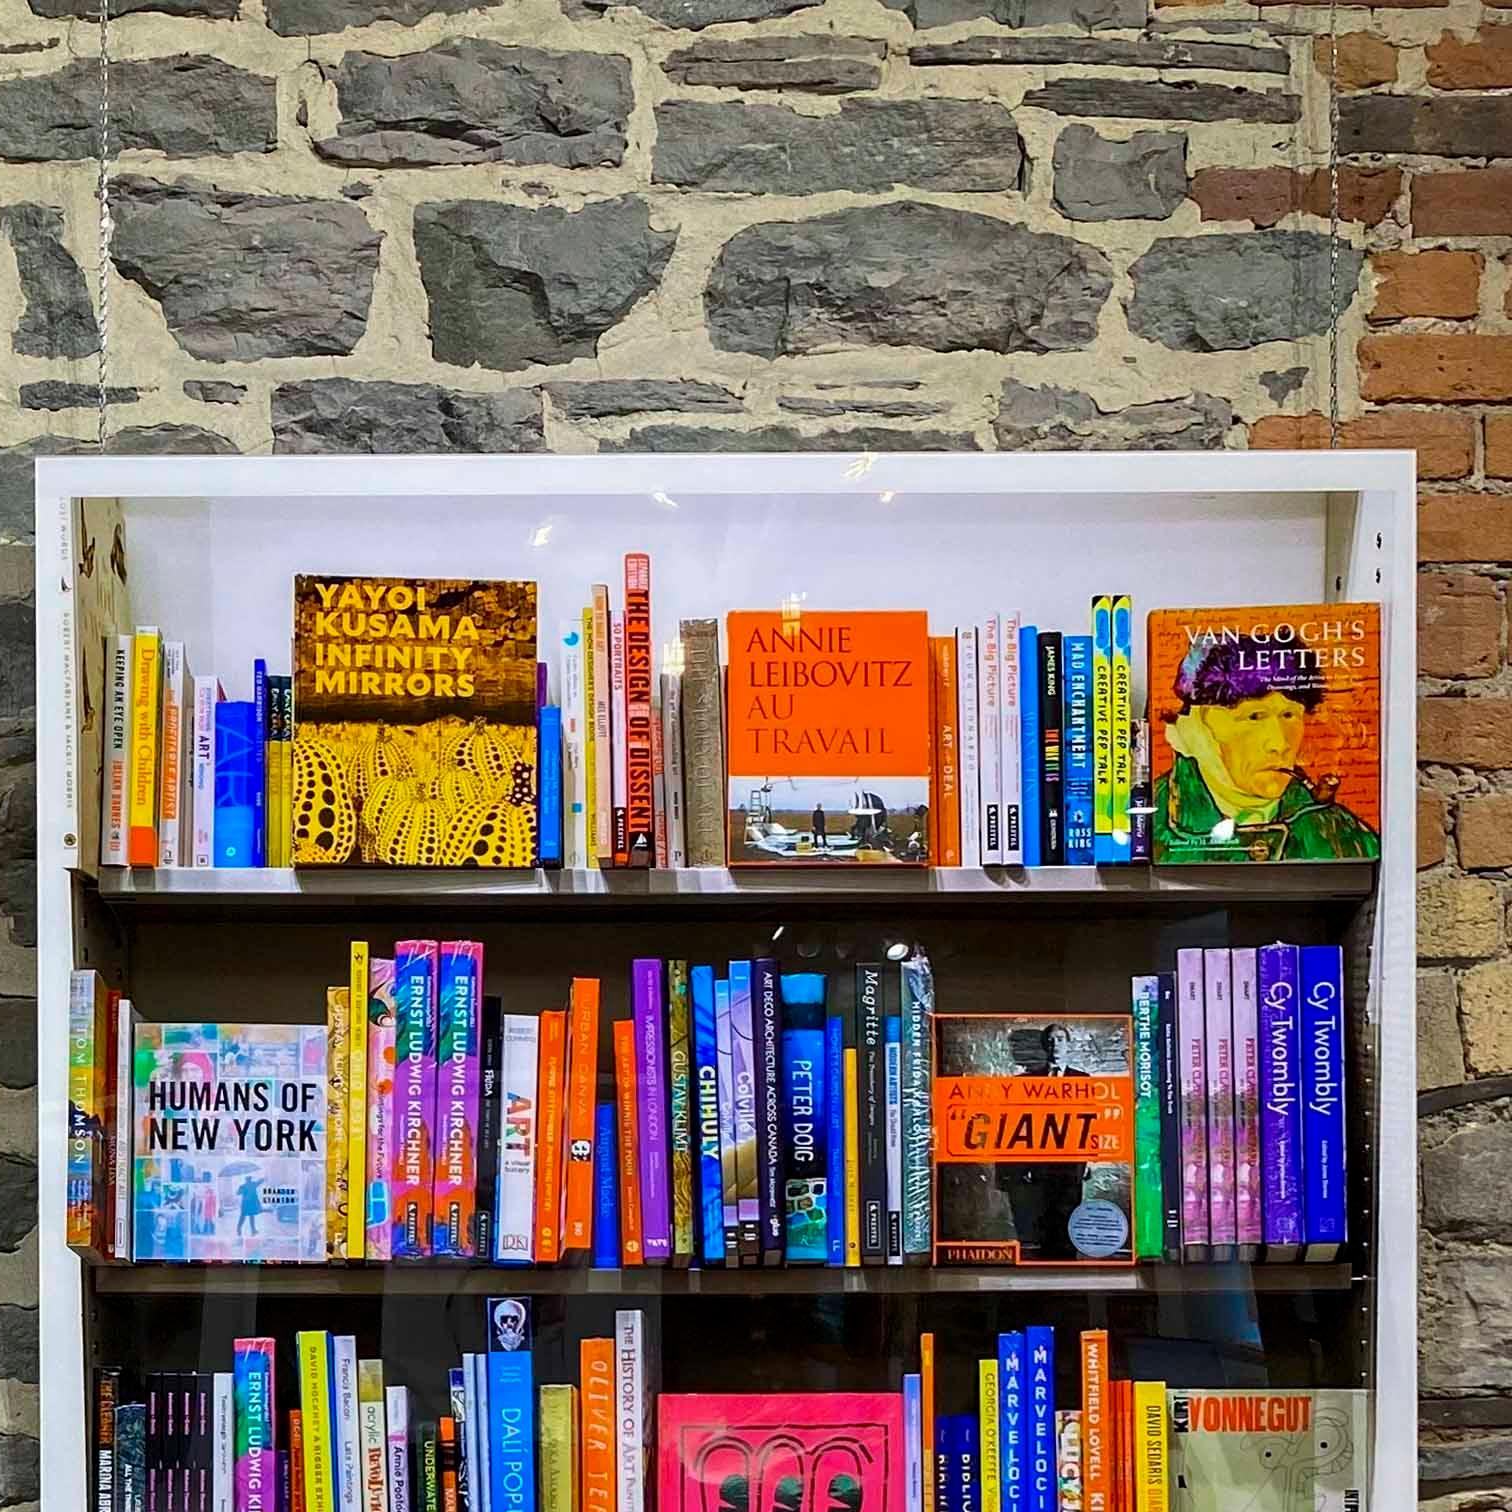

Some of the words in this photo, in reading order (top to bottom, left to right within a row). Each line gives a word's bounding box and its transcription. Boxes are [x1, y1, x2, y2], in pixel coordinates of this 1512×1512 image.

[315, 583, 426, 611] YAYOI
[626, 590, 649, 626] THE
[315, 612, 480, 641] KUSAMA
[746, 627, 851, 653] ANNIE
[1184, 624, 1240, 646] VAN
[1250, 620, 1365, 644] GOGH'S
[315, 643, 473, 671] INFINITY
[627, 631, 650, 704] DESIGN
[750, 661, 912, 688] LEIBOVITZ
[1070, 642, 1085, 670] MAD
[1238, 648, 1365, 671] LETTERS
[315, 671, 475, 698] MIRRORS
[747, 696, 793, 720] AU
[1070, 674, 1085, 769] ENCHANTMENT
[628, 716, 650, 741] OF
[747, 728, 893, 754] TRAVAIL
[629, 747, 652, 833] DISSENT
[410, 975, 425, 1027] ERNST
[862, 970, 879, 1046] Magritte
[1306, 981, 1335, 1011] Cy
[75, 1026, 88, 1065] TOM
[407, 1032, 424, 1096] LUDWIG
[1308, 1016, 1336, 1116] Twombly
[149, 1082, 269, 1112] HUMANS
[281, 1082, 317, 1112] OF
[792, 1060, 813, 1117] PETER
[73, 1073, 88, 1165] THOMSON
[506, 1092, 530, 1156] ART
[698, 1066, 717, 1160] CHIHULY
[149, 1120, 219, 1151] NEW
[229, 1120, 317, 1152] YORK
[405, 1101, 421, 1186] KIRCHNER
[793, 1122, 814, 1162] DOIG
[948, 1248, 1013, 1260] PHAIDON
[248, 1372, 262, 1422] ERNST
[1086, 1343, 1100, 1423] WHITFIELD
[502, 1407, 521, 1452] DALÍ
[1147, 1405, 1162, 1437] DAVID
[1187, 1396, 1312, 1433] VONNEGUT
[248, 1426, 261, 1490] LUDWIG
[1088, 1428, 1101, 1480] LOVELL
[1146, 1440, 1162, 1486] SEDARIS
